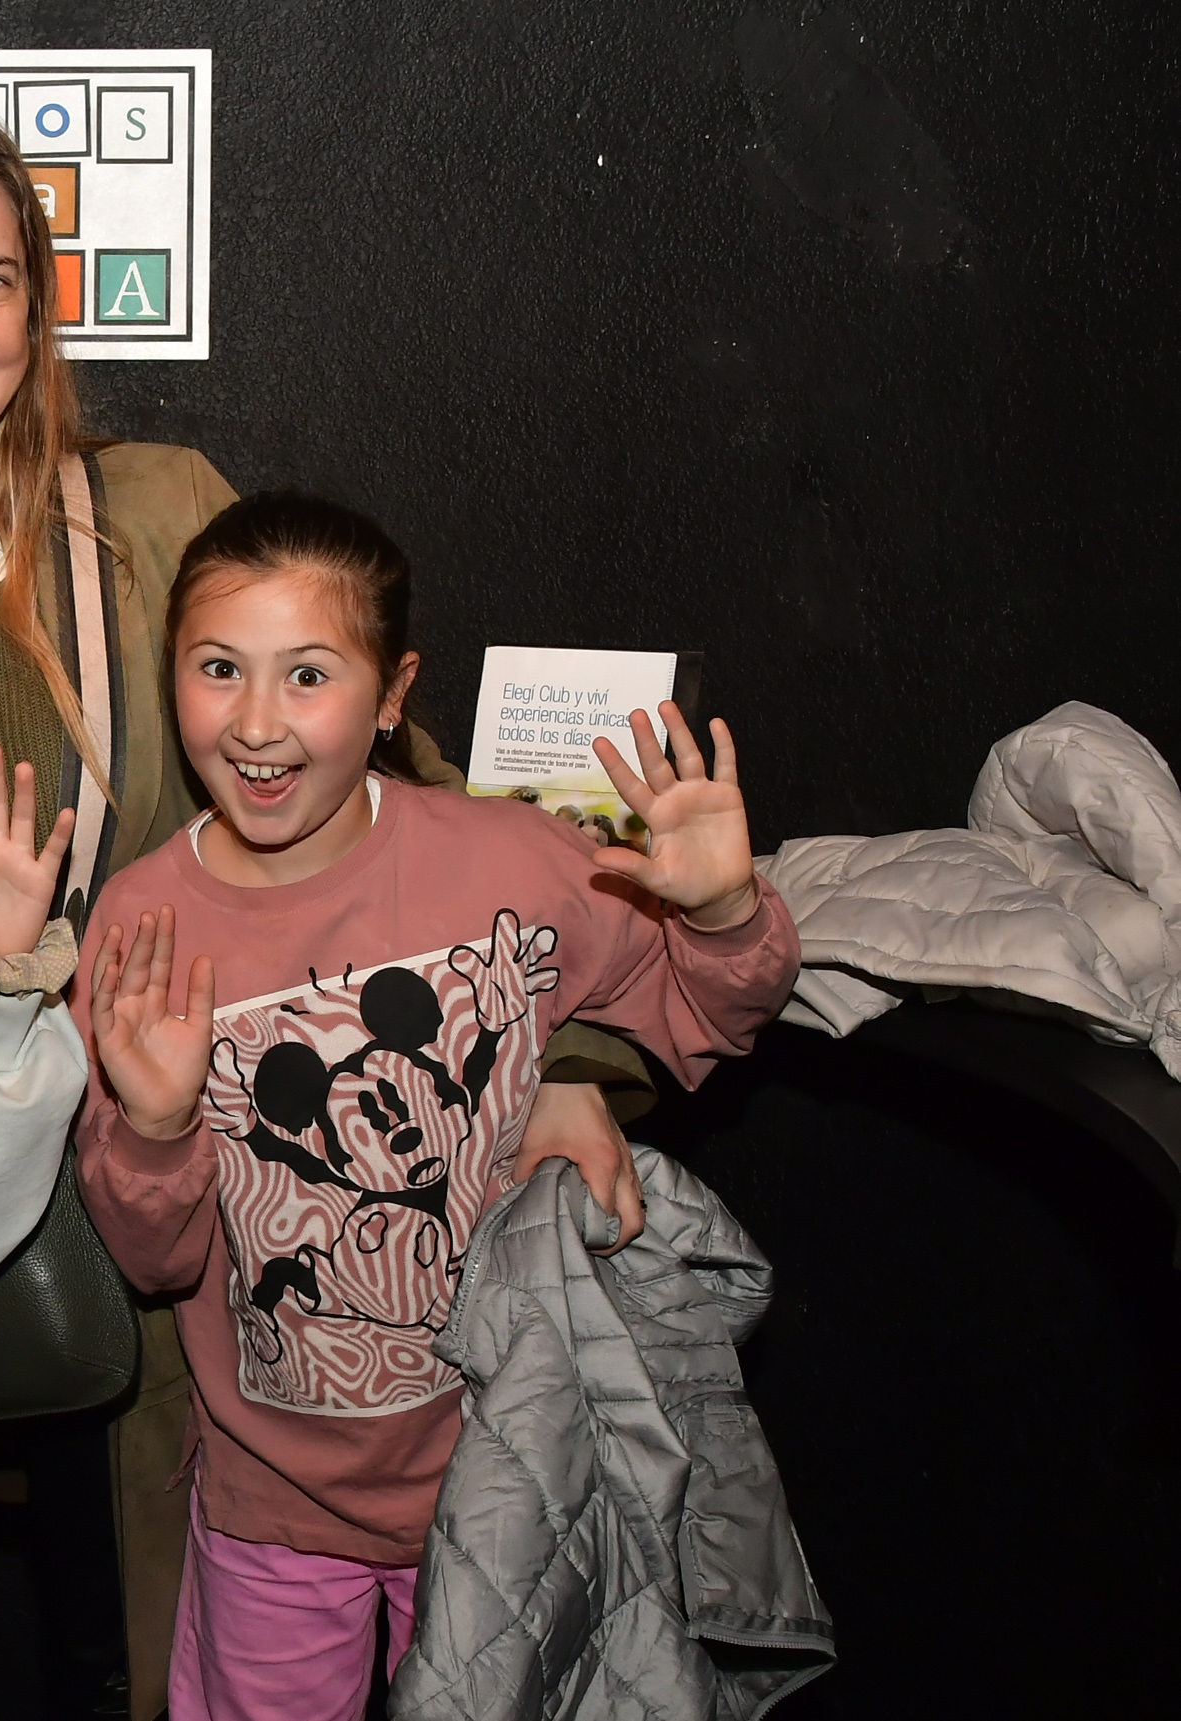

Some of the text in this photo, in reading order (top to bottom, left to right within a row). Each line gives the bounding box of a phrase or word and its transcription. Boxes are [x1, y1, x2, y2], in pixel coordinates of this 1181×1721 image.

[502, 683, 610, 707] Elegí Club y viví
[500, 706, 631, 728] experiencias únicas
[498, 724, 591, 746] todos los días
[502, 756, 547, 765] establecimientos
[511, 748, 533, 756] disfrutar
[534, 750, 561, 758] beneficios
[493, 763, 532, 773] Coleccionables
[533, 766, 539, 774] El
